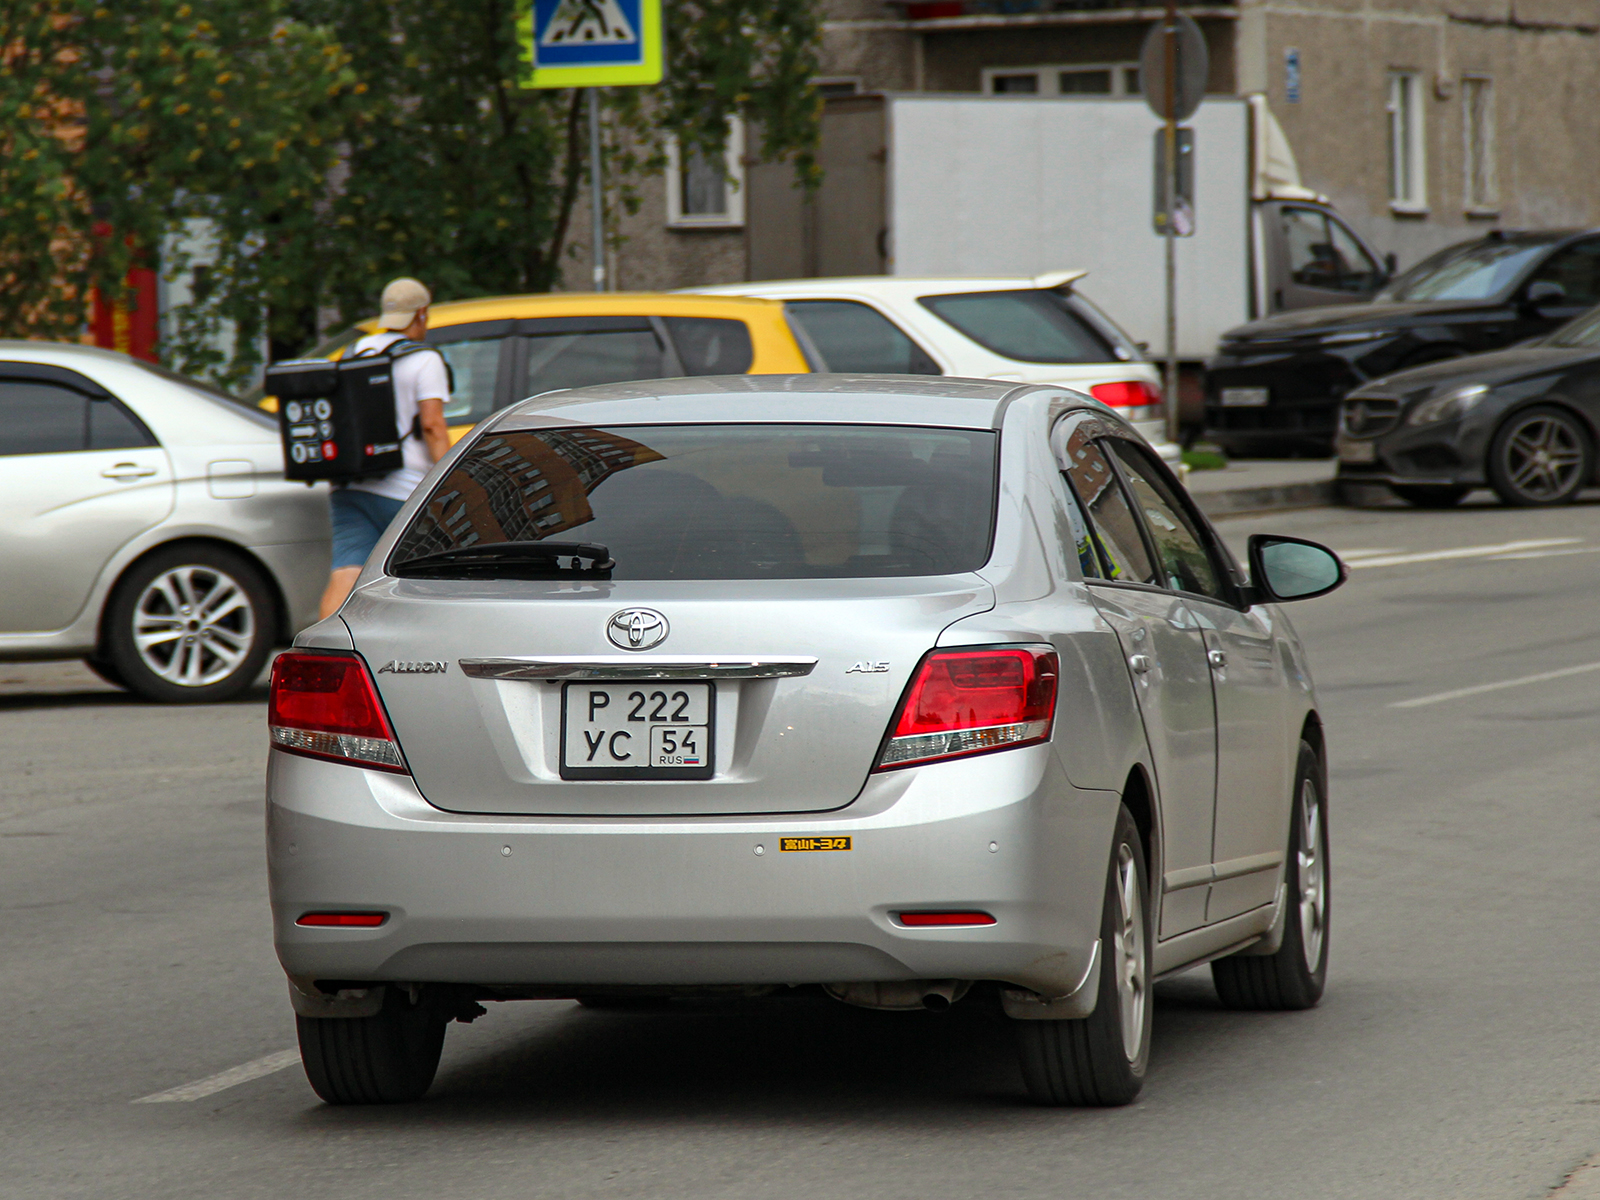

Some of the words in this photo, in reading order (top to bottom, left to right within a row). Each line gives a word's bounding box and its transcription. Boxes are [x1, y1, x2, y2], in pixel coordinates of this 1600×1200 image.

[377, 660, 449, 674] ALLION
[845, 660, 890, 674] A15
[627, 690, 690, 722] 222
[661, 730, 697, 755] 54
[659, 755, 683, 765] RUS
